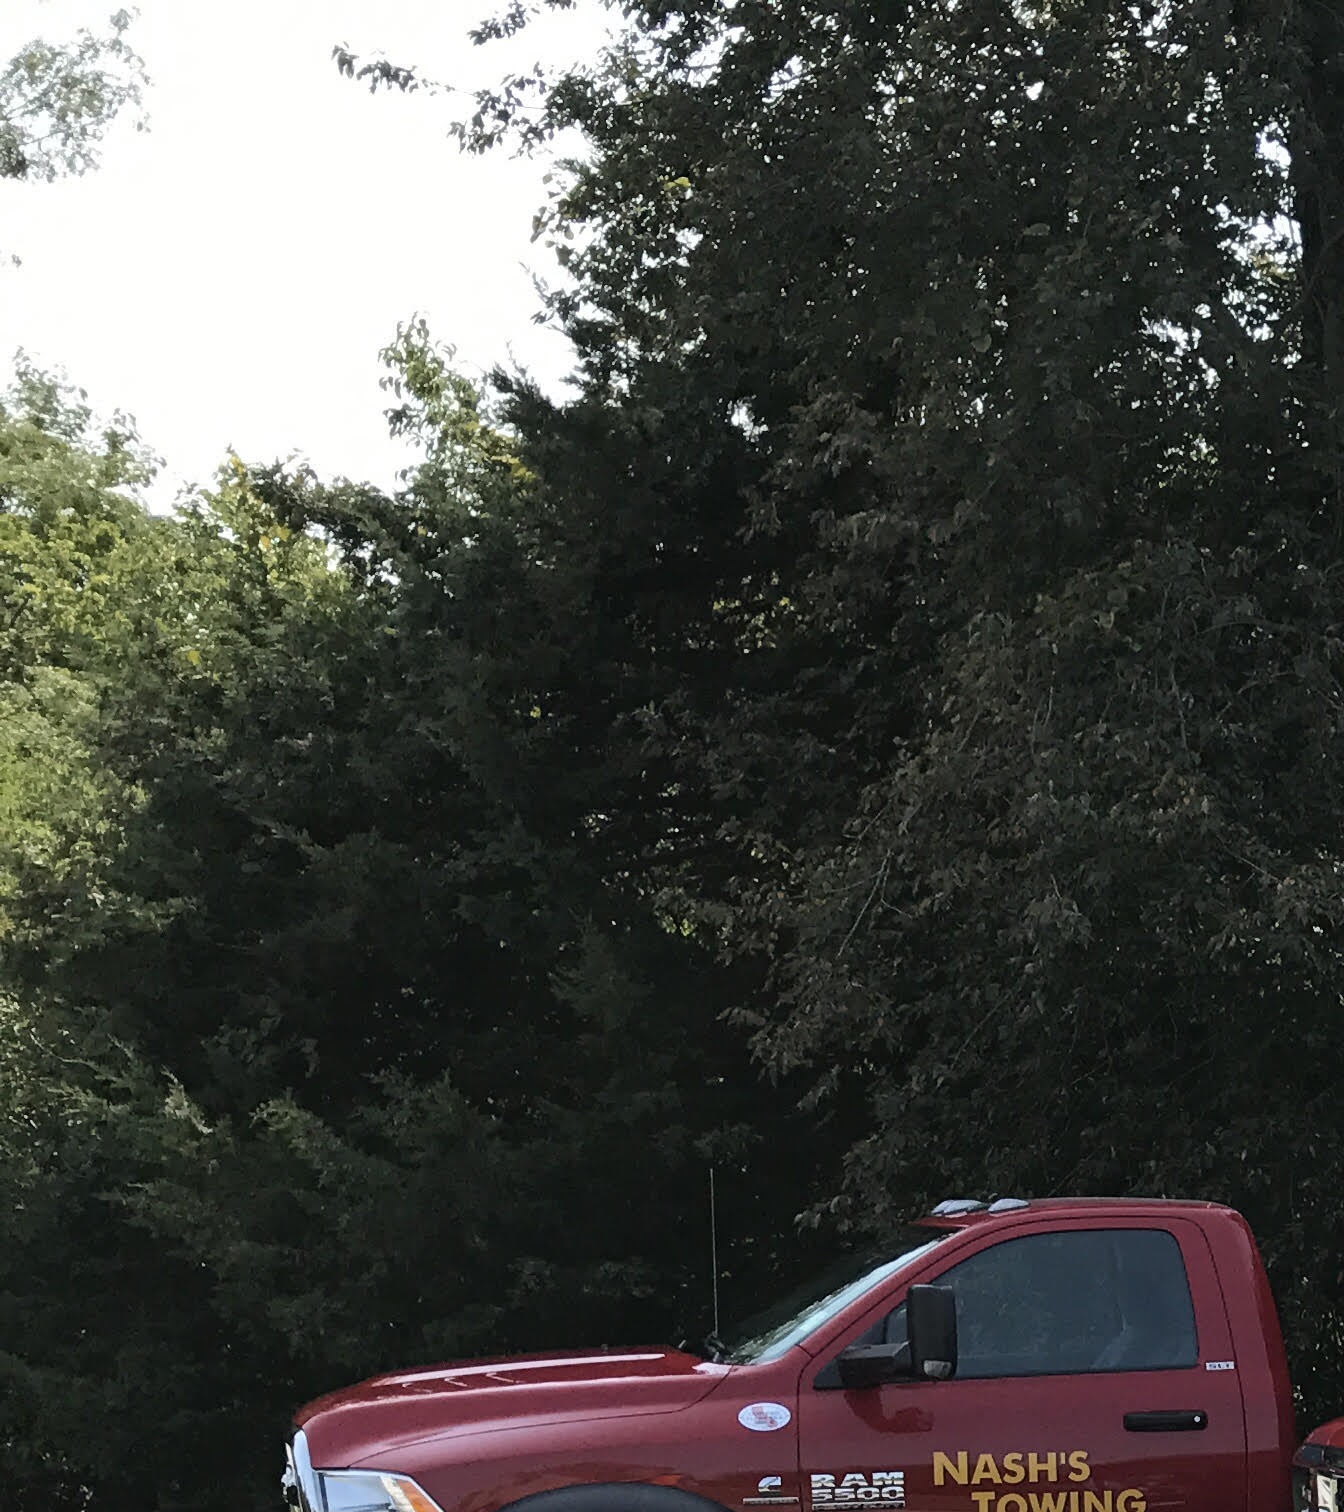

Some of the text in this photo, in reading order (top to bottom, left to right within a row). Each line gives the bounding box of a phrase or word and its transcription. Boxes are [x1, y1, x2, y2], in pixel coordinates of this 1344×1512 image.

[932, 1449, 1091, 1486] NASH'S
[811, 1472, 904, 1488] RAM
[812, 1487, 905, 1503] 5500
